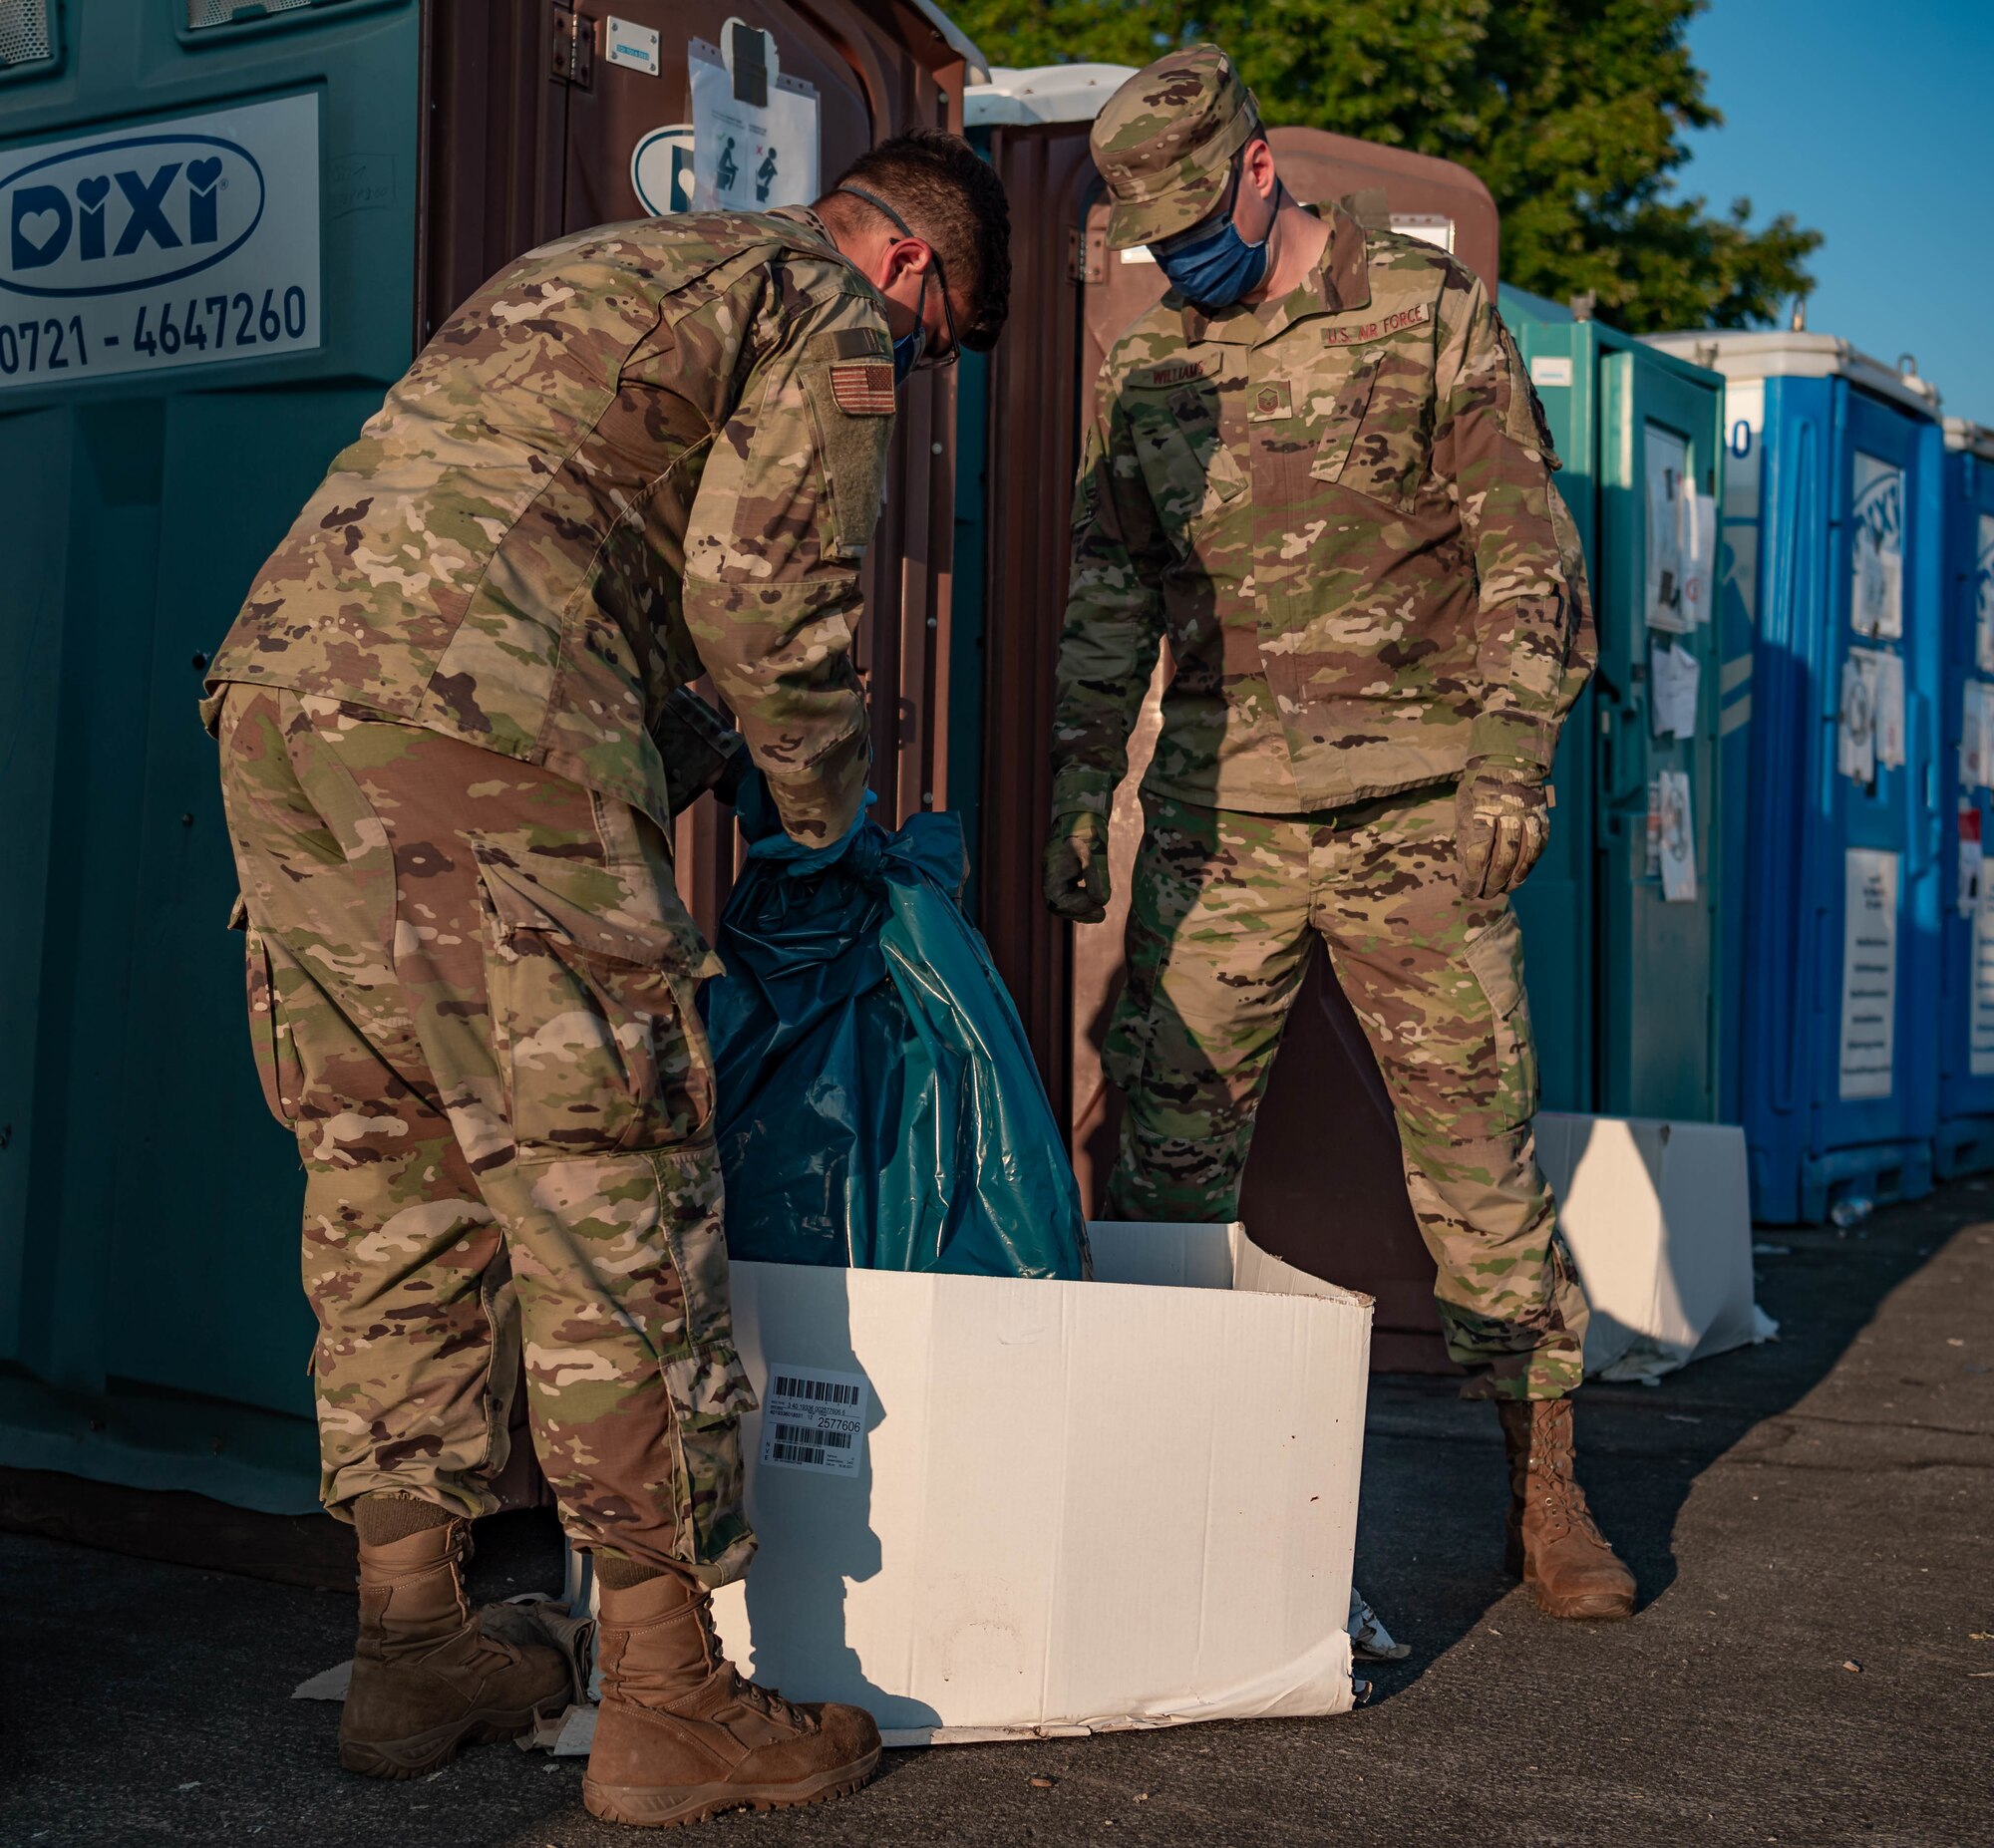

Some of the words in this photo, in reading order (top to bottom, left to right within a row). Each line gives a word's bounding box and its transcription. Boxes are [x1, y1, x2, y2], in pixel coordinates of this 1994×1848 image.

[0, 315, 88, 375] 0721
[134, 285, 306, 357] 4647260
[1326, 327, 1352, 344] U.S.
[1357, 323, 1378, 340] AIR
[1383, 305, 1423, 333] FORCE
[818, 1416, 860, 1432] 2577606
